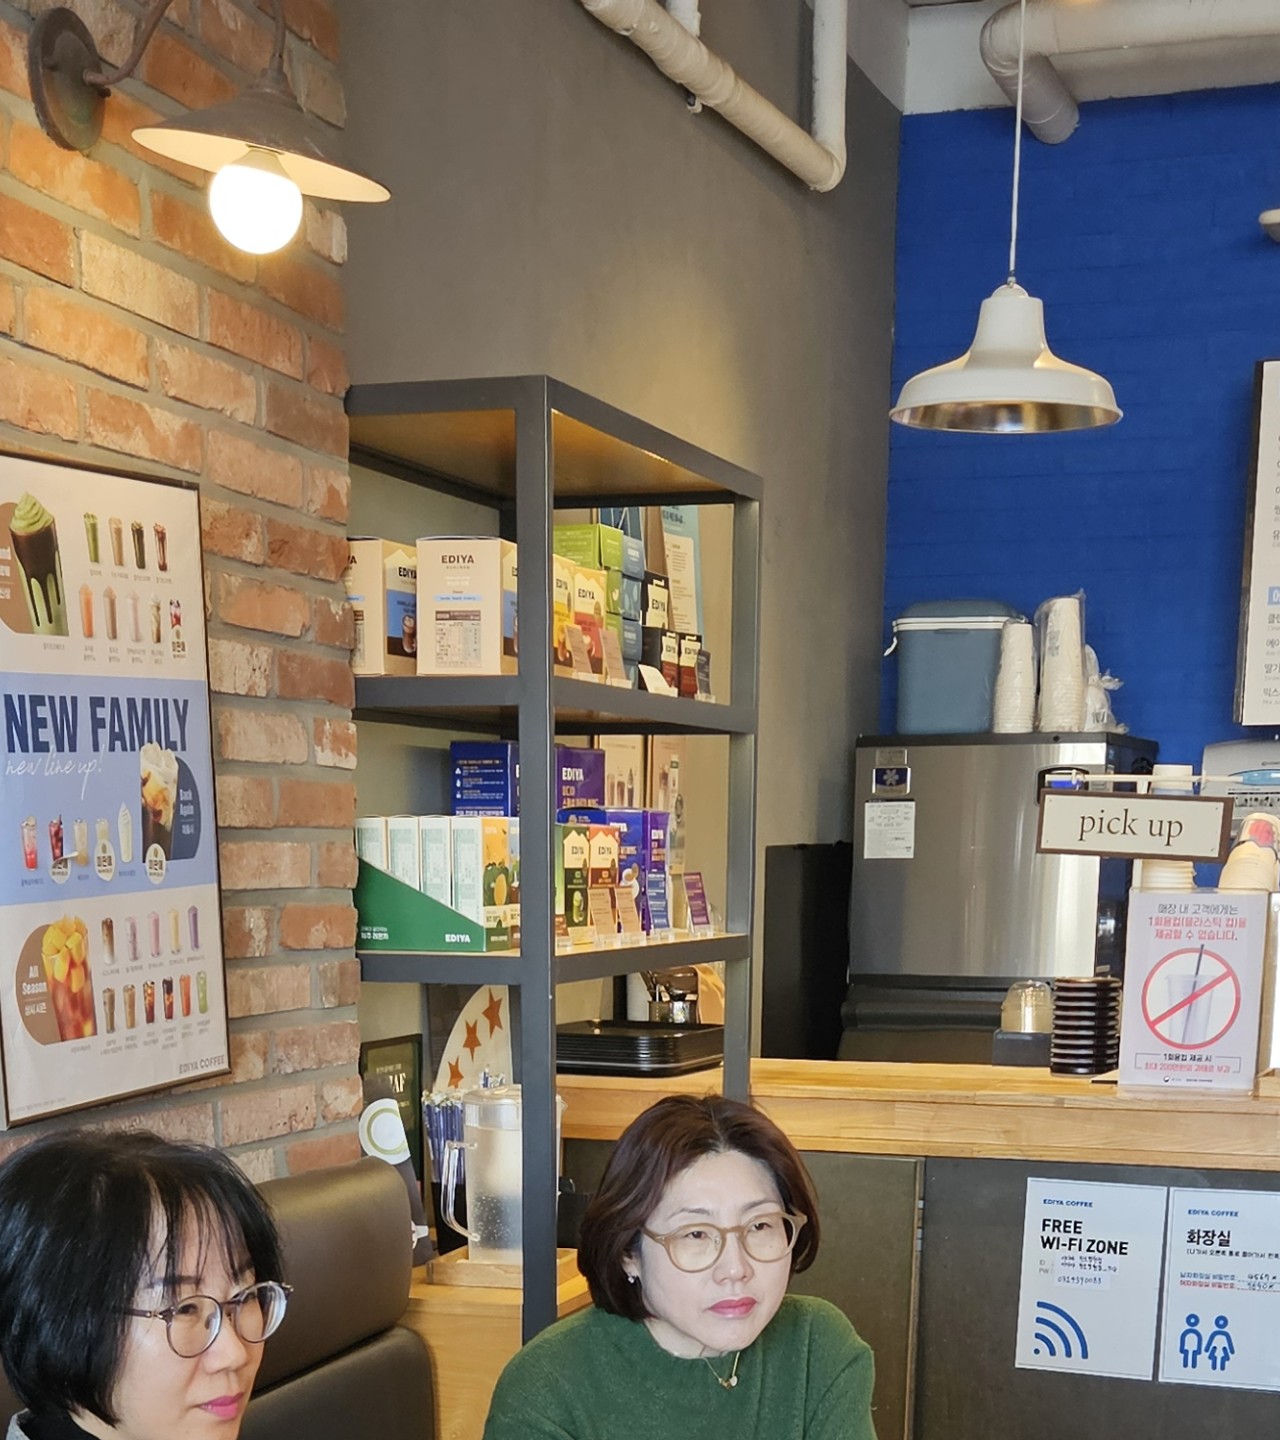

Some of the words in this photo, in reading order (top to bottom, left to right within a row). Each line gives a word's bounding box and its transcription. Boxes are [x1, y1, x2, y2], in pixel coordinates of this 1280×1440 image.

[441, 555, 475, 564] EDIYA
[578, 588, 595, 600] EDIYA
[652, 599, 666, 611] EDIYA
[4, 694, 78, 753] NEW
[90, 696, 188, 752] FAMILY
[5, 758, 41, 776] new
[44, 745, 76, 776] line
[562, 767, 584, 781] EDIYA
[1078, 808, 1138, 841] pick
[1148, 819, 1183, 846] up
[1158, 904, 1176, 915] 매장
[1179, 904, 1189, 914] 내
[1192, 904, 1239, 915] 고객에게는
[445, 934, 470, 943] EDIYA
[1155, 930, 1182, 940] 제공할
[1185, 930, 1194, 940] 수
[1198, 930, 1238, 941] 없습니다.
[29, 965, 39, 978] All
[22, 982, 47, 995] Season
[179, 1063, 199, 1074] EDIYA
[200, 1055, 225, 1069] COFFEE
[1041, 1219, 1083, 1234] FREE
[1187, 1229, 1231, 1247] 화장실
[1040, 1236, 1083, 1251] WI-FI
[1086, 1240, 1128, 1255] ZONE
